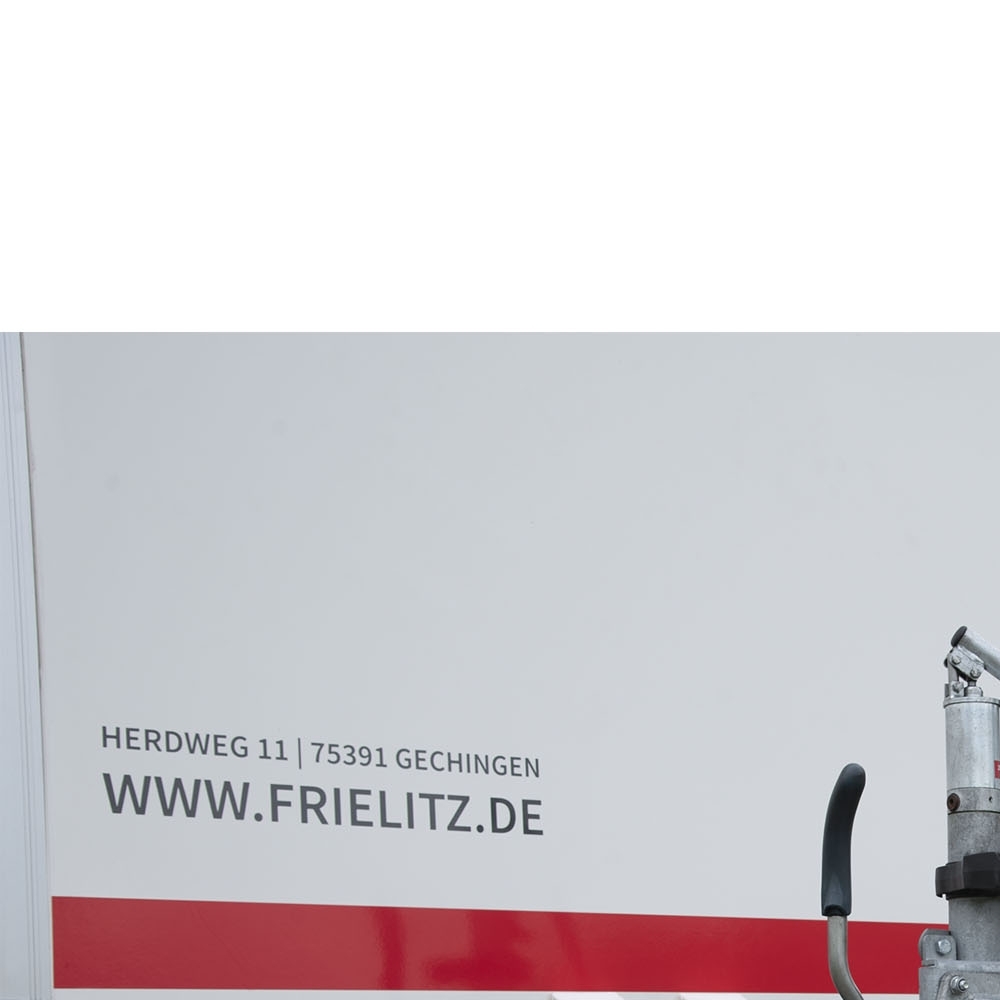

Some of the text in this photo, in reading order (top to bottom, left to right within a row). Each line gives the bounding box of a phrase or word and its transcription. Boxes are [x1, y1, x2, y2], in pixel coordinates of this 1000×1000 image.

[101, 726, 540, 778] HERDWEG 11 75391 GECHINGEN
[102, 772, 544, 836] WWW.FRIELITZ.DE
